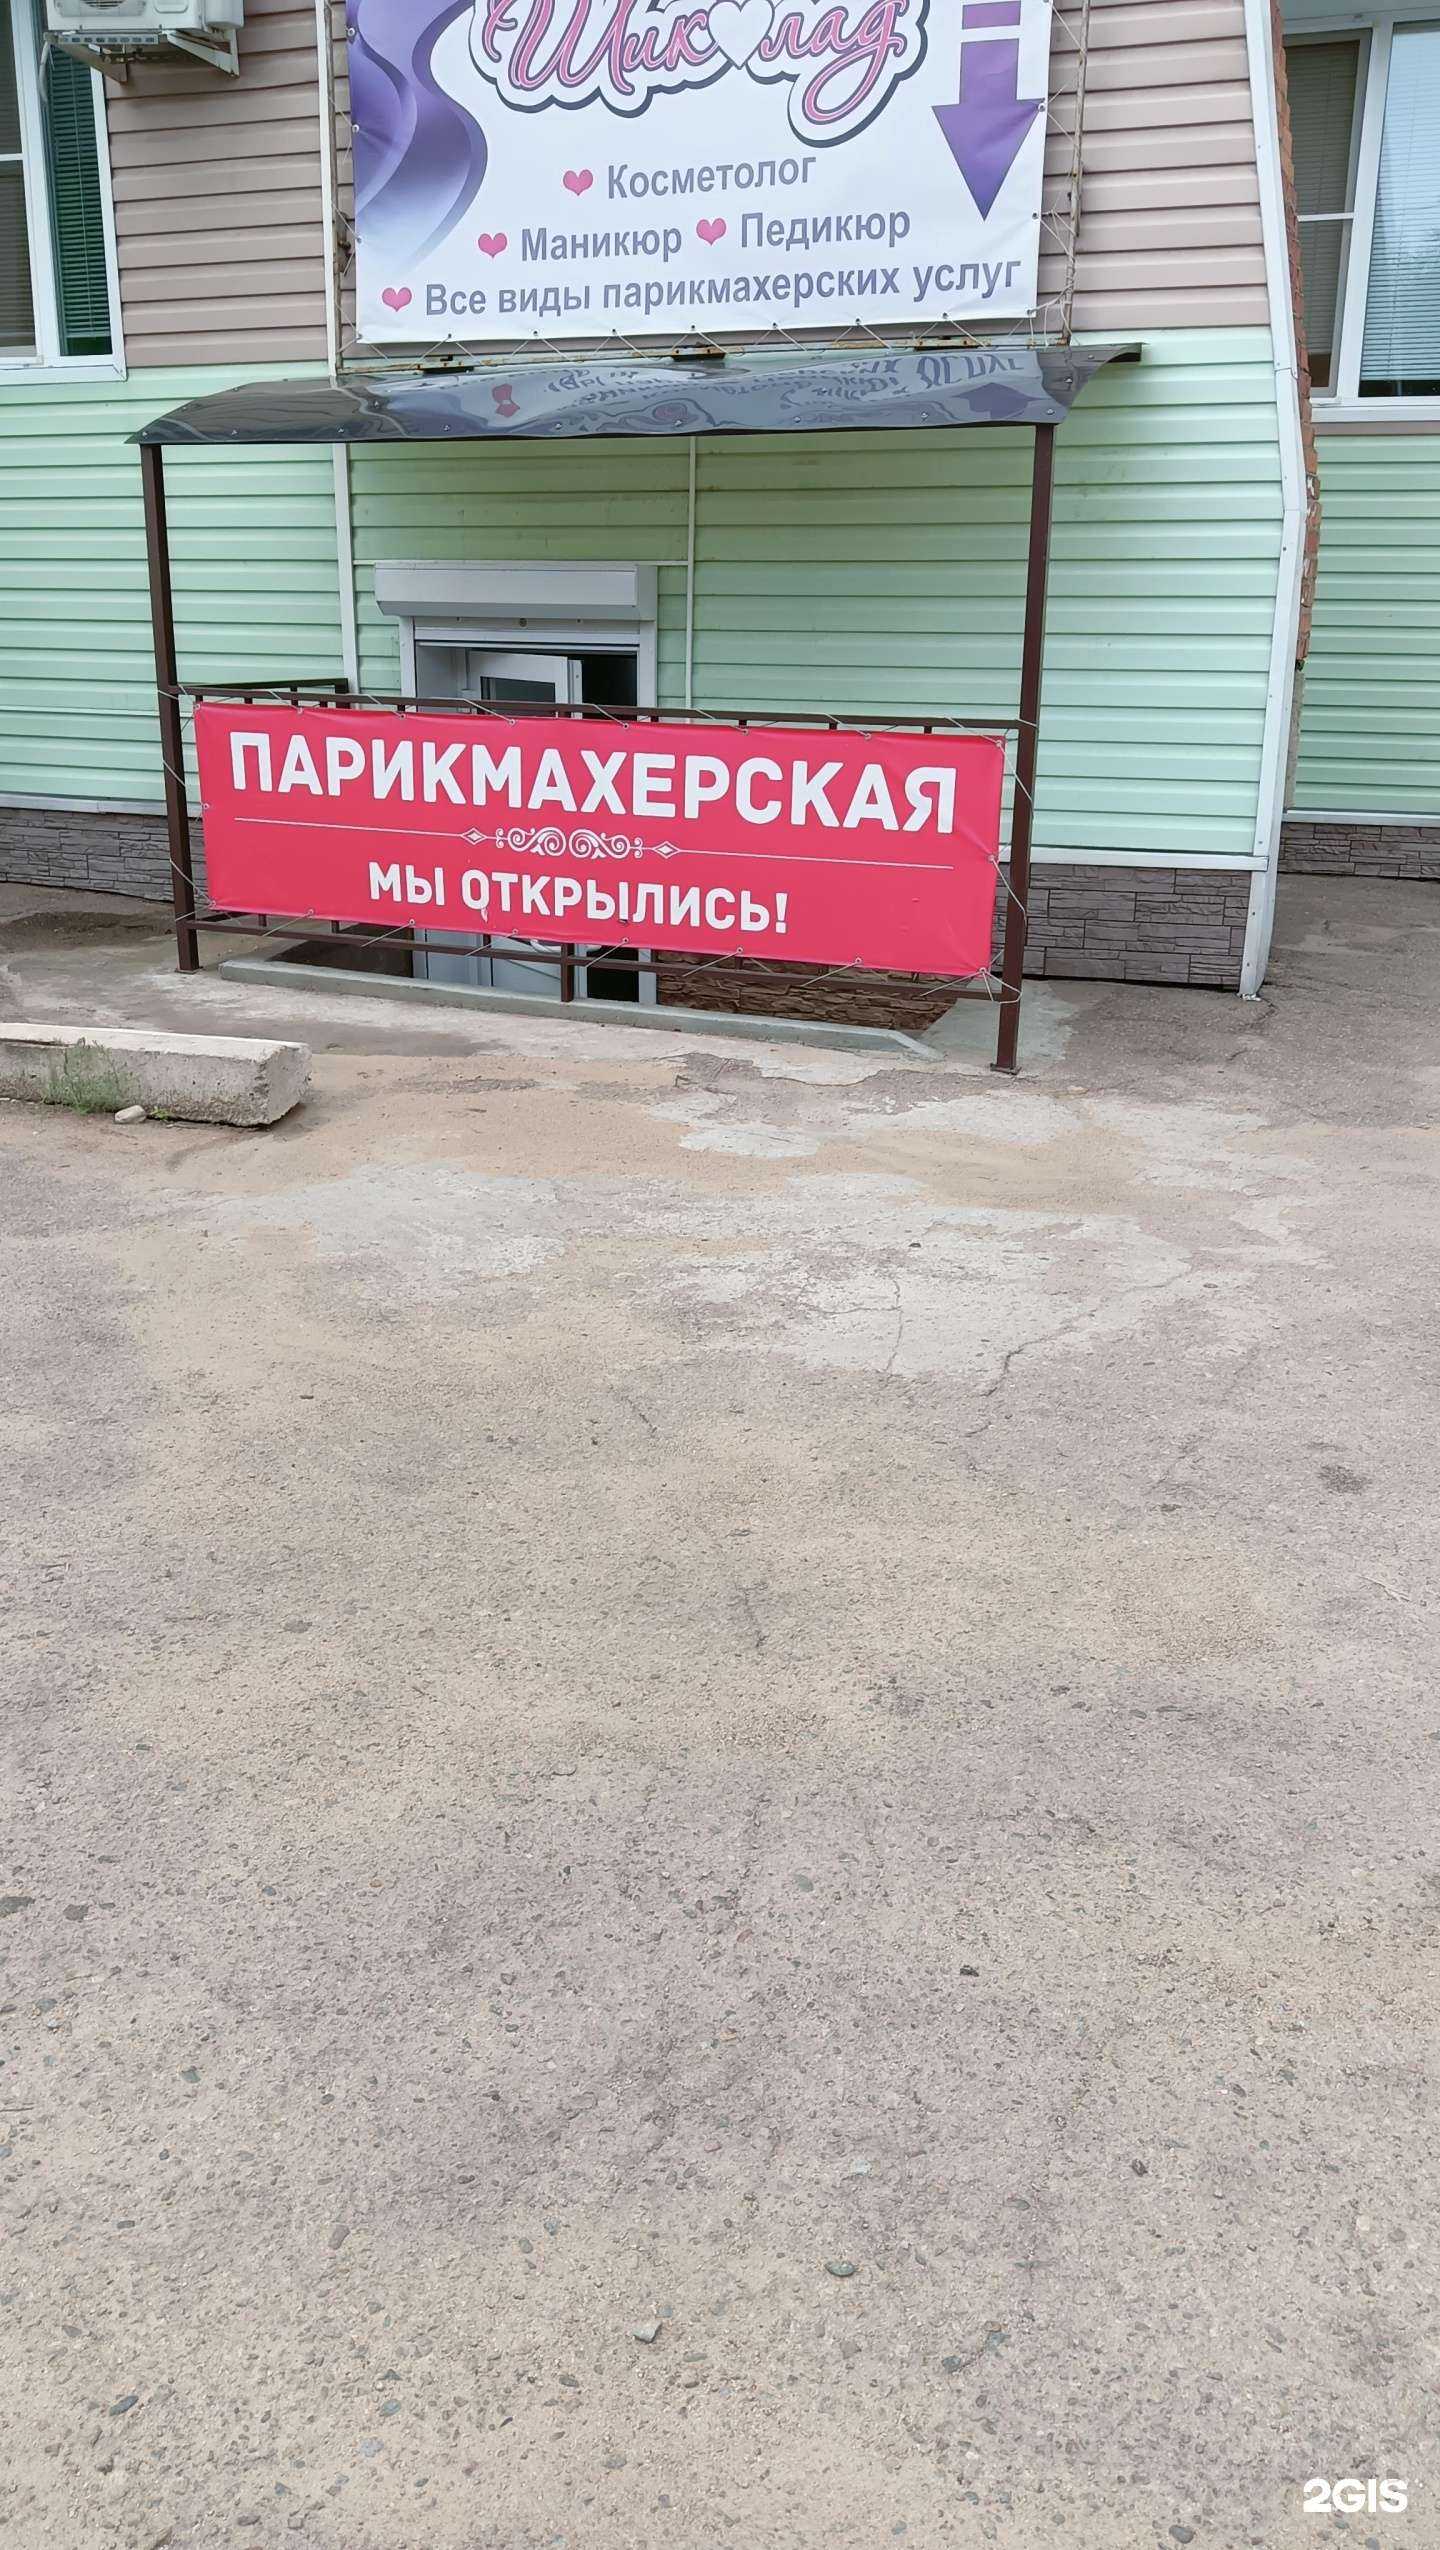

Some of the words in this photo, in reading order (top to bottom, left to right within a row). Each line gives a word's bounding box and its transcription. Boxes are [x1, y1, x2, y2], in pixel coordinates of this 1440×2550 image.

[608, 156, 817, 199] Косметолог
[520, 228, 683, 262] Маникюр
[740, 210, 911, 251] Педикюр
[425, 284, 487, 316] Все
[498, 285, 591, 317] виды
[602, 267, 900, 315] парикмахерских
[912, 260, 1022, 303] услуг
[229, 731, 957, 833] ПАРИКМАХЕРСКАЯ
[368, 861, 445, 906] МЫ
[461, 869, 789, 934] ОТКРЫЛИСЬ!
